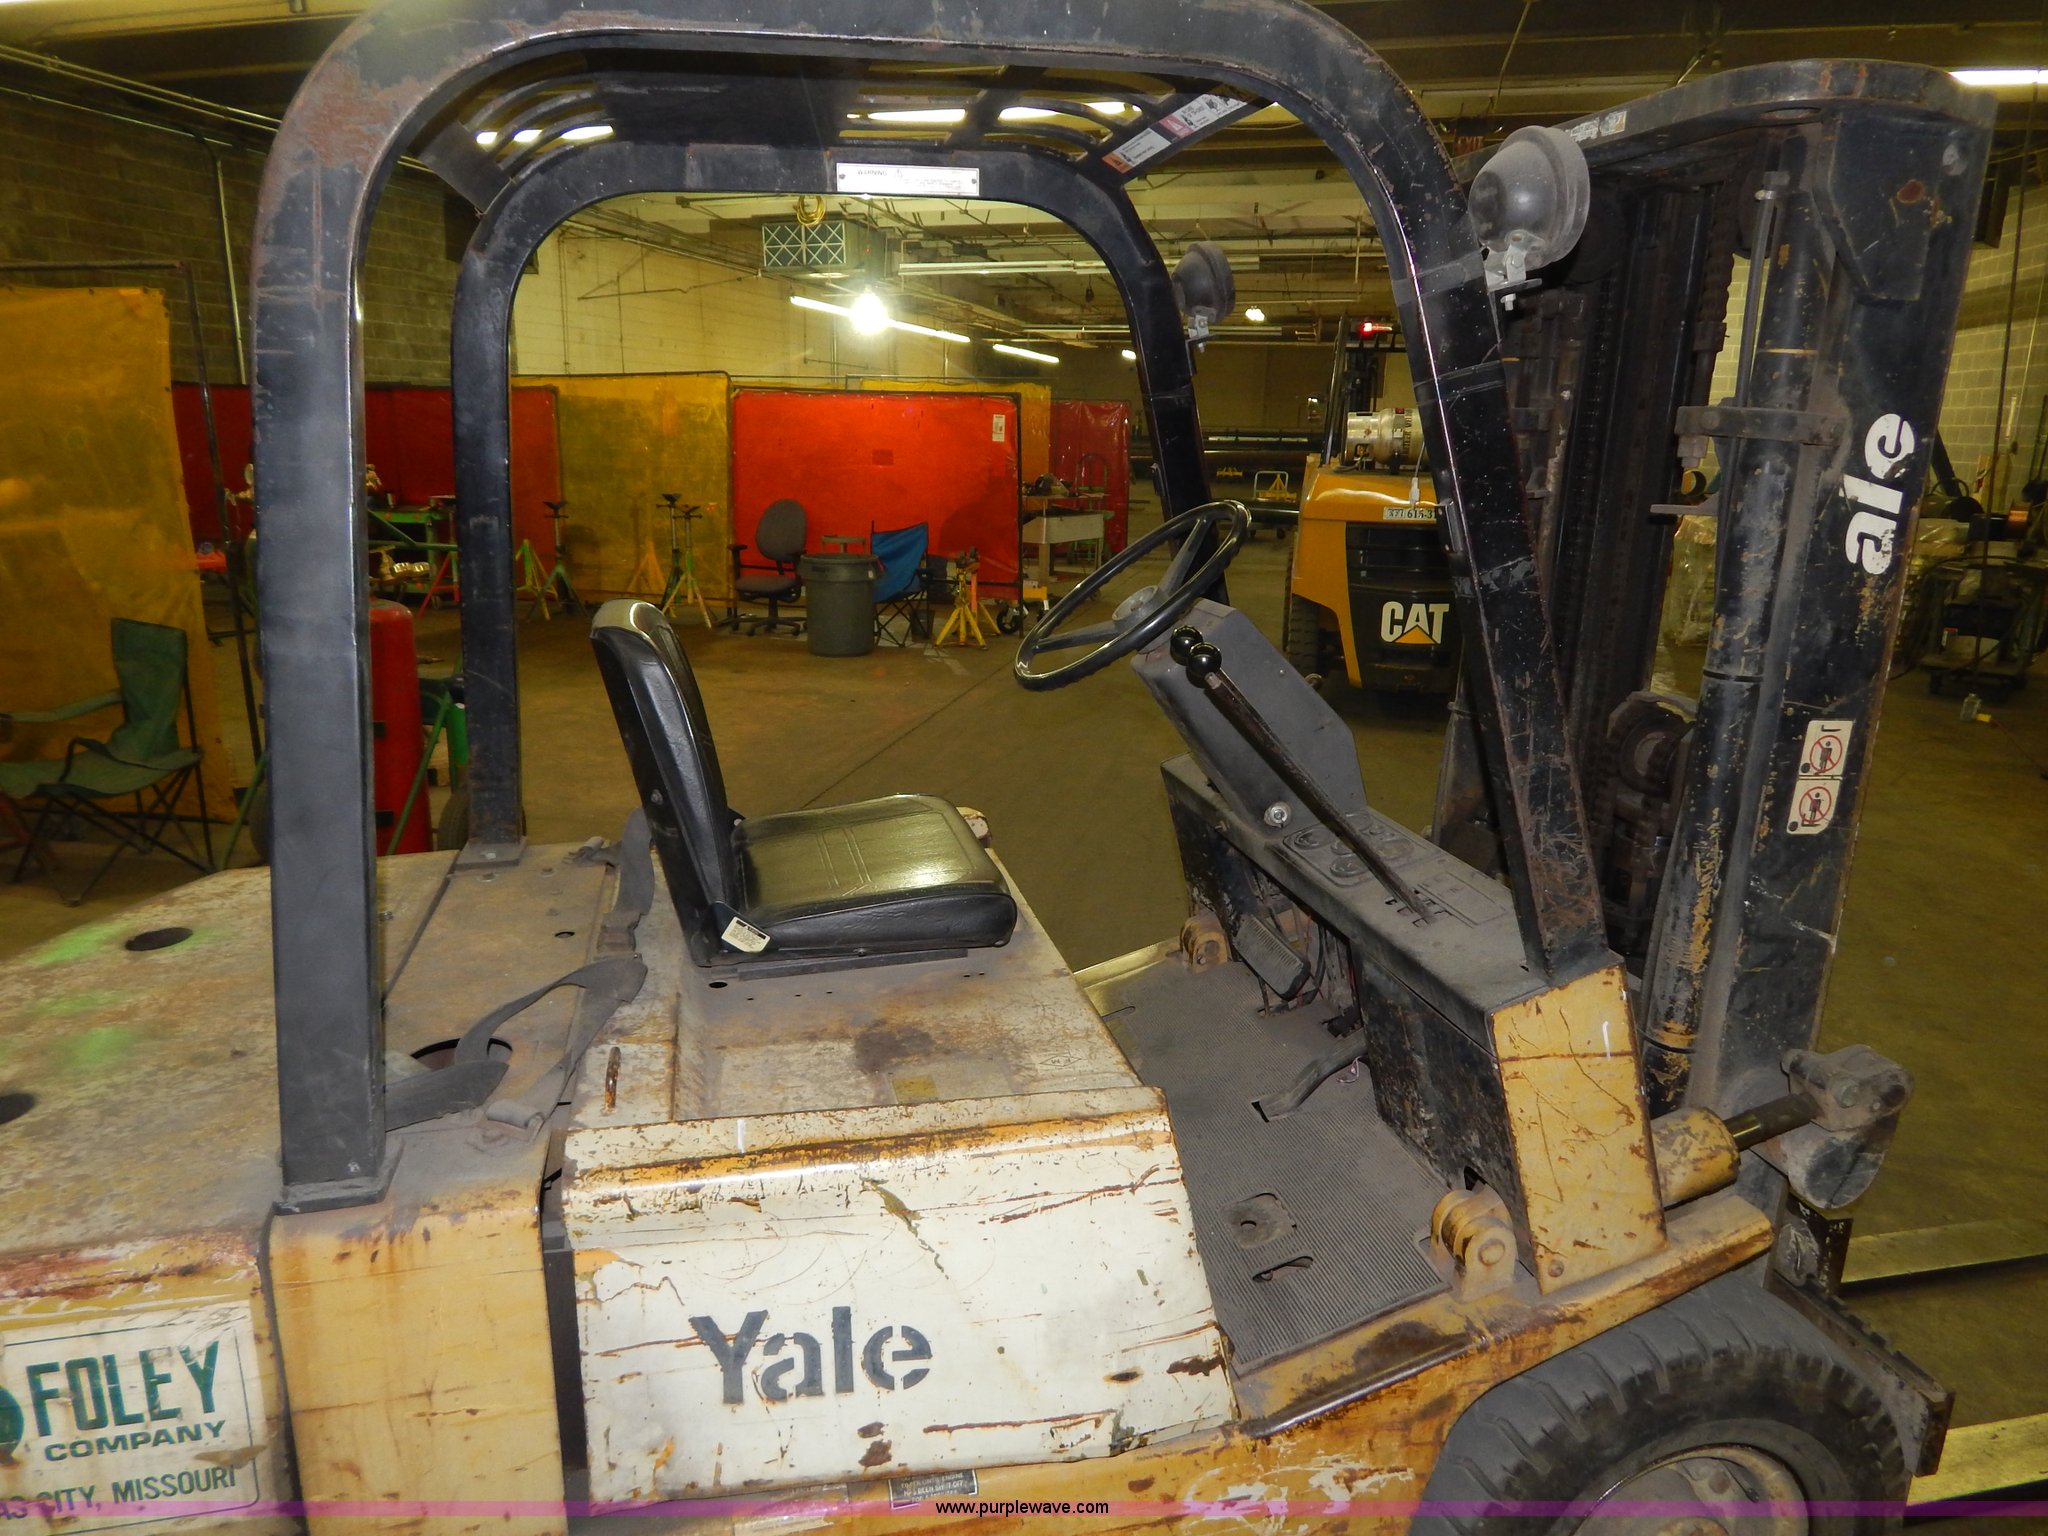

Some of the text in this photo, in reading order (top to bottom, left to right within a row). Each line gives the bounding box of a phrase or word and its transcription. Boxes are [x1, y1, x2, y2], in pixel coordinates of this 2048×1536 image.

[1381, 601, 1450, 645] CAT
[688, 1306, 933, 1404] Yale
[26, 1340, 219, 1437] FOLEY
[44, 1420, 226, 1462] COMPANY
[111, 1464, 237, 1505] MISSOURI
